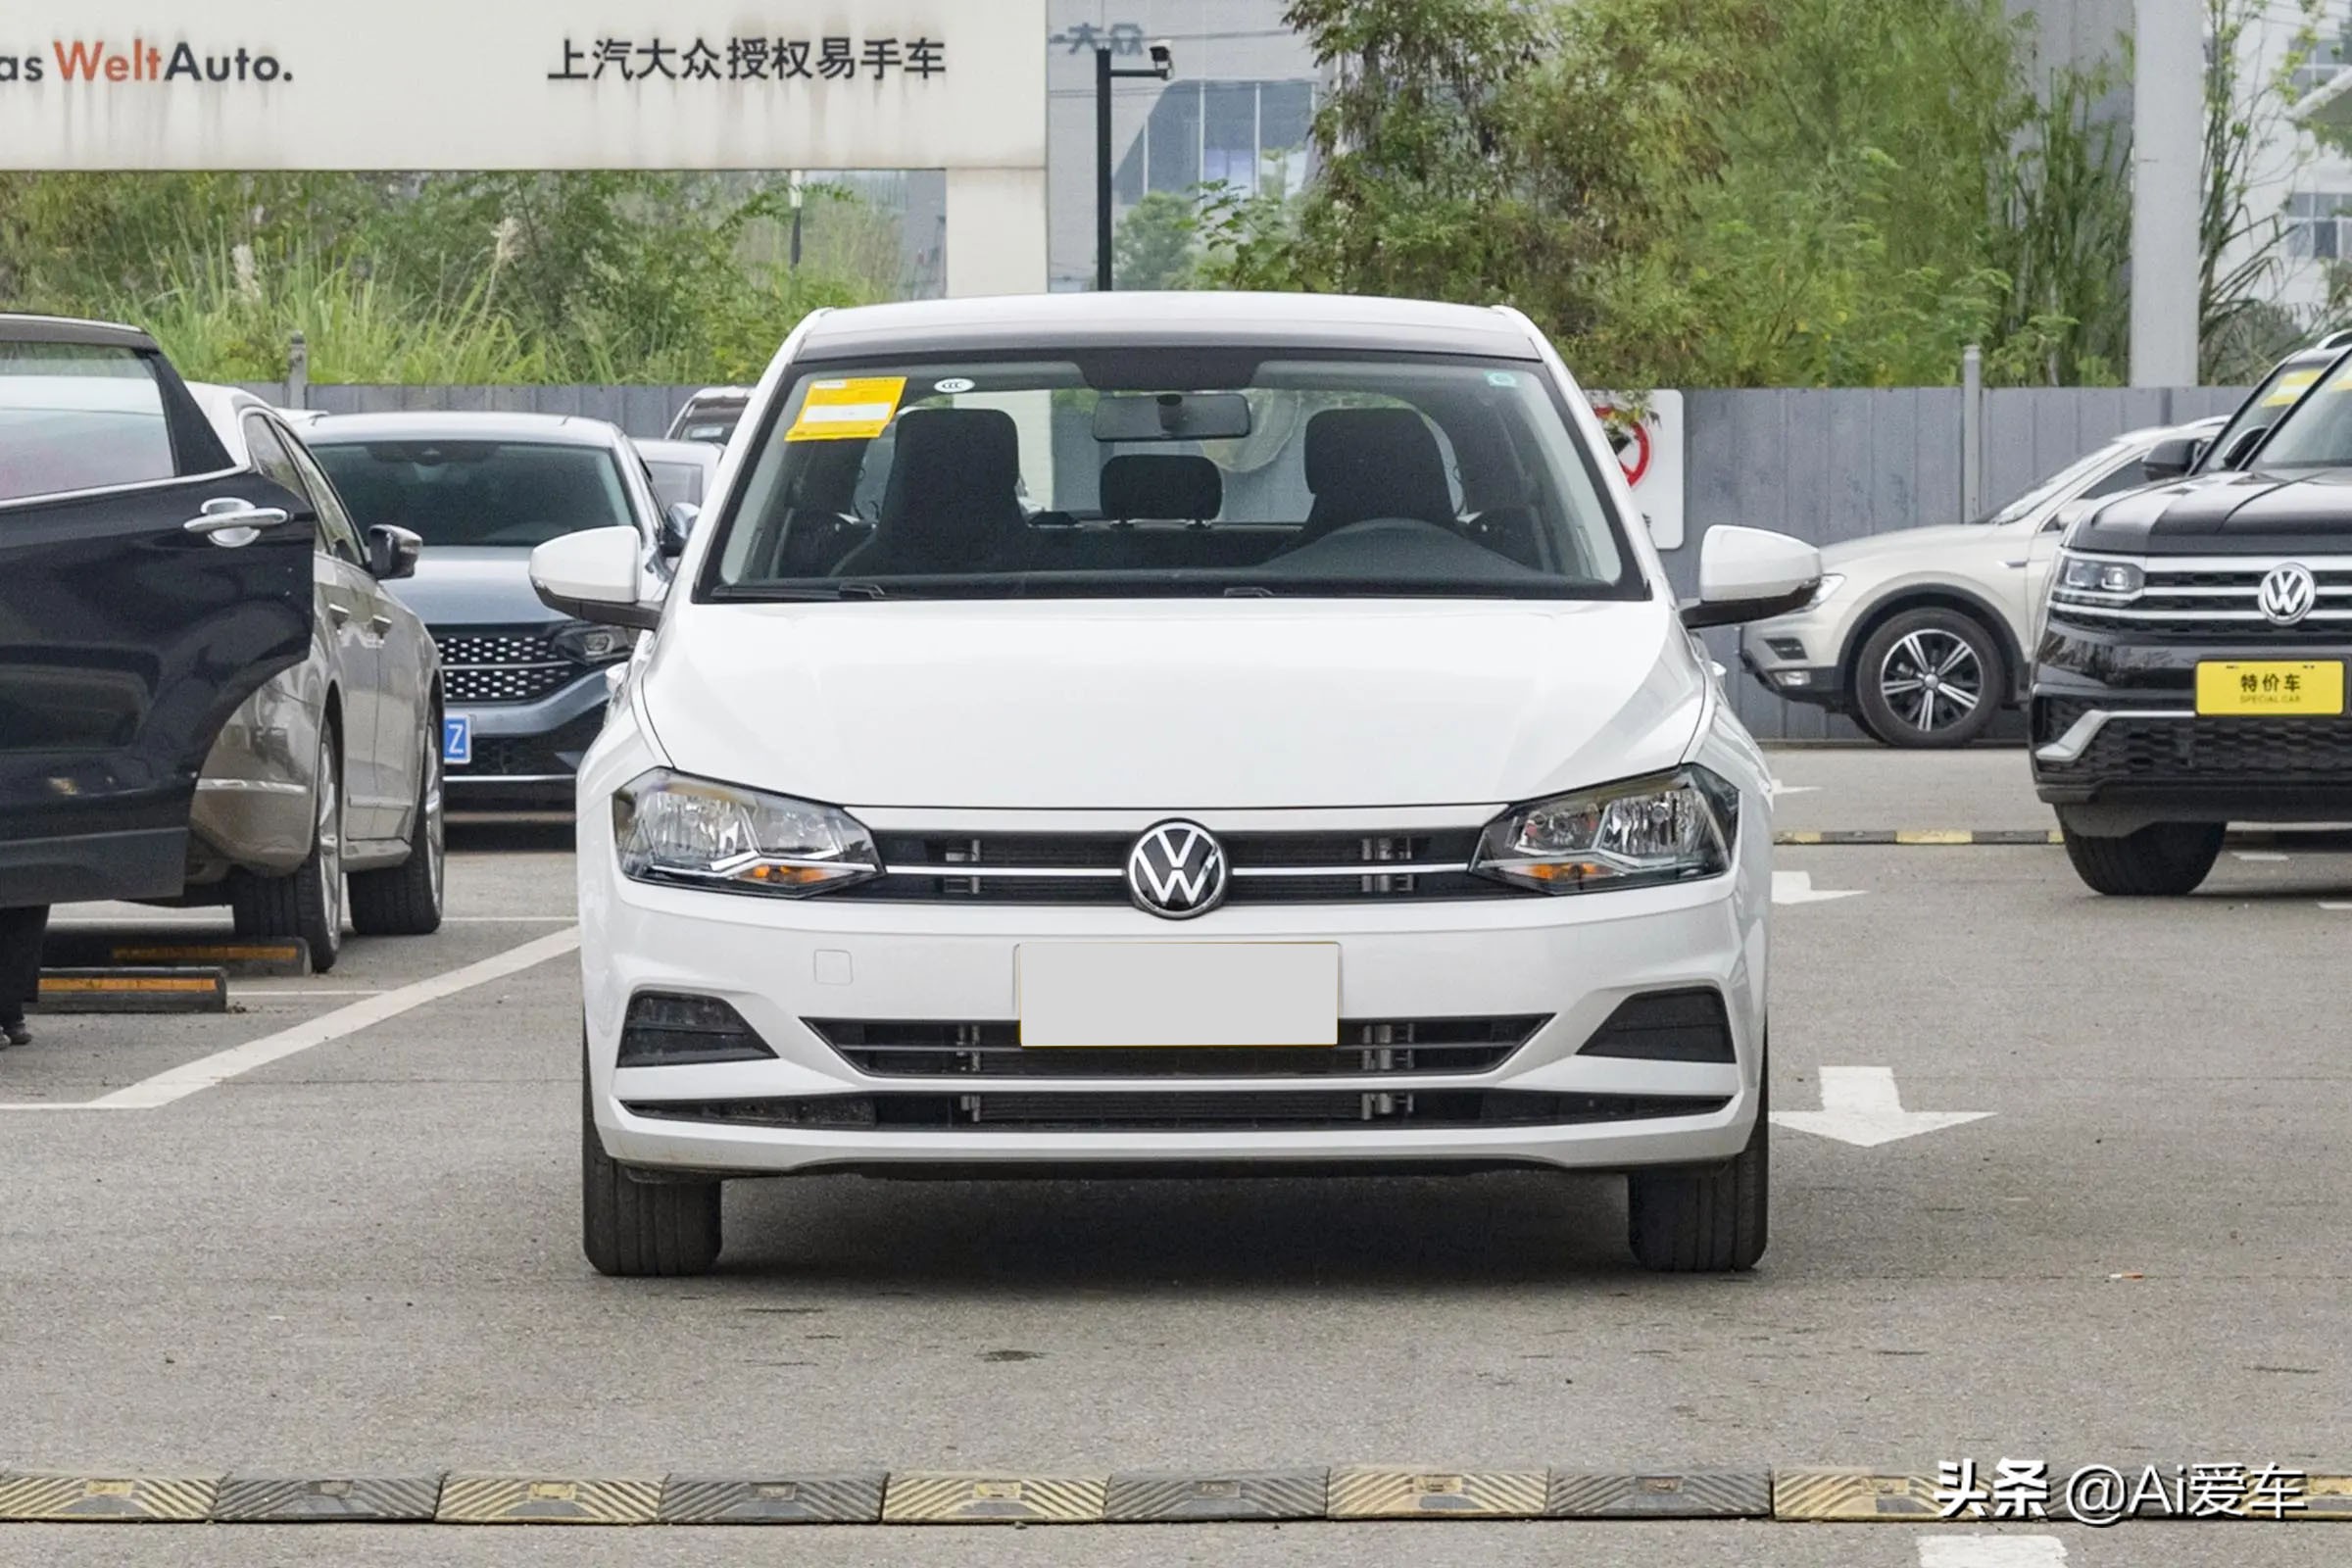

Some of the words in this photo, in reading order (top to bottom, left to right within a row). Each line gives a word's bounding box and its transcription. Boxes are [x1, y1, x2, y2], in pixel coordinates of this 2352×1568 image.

[52, 38, 293, 81] WeltAuto.
[547, 37, 947, 81] 上汽大众授权易手车
[2240, 673, 2301, 693] 特价车
[448, 723, 465, 754] Z
